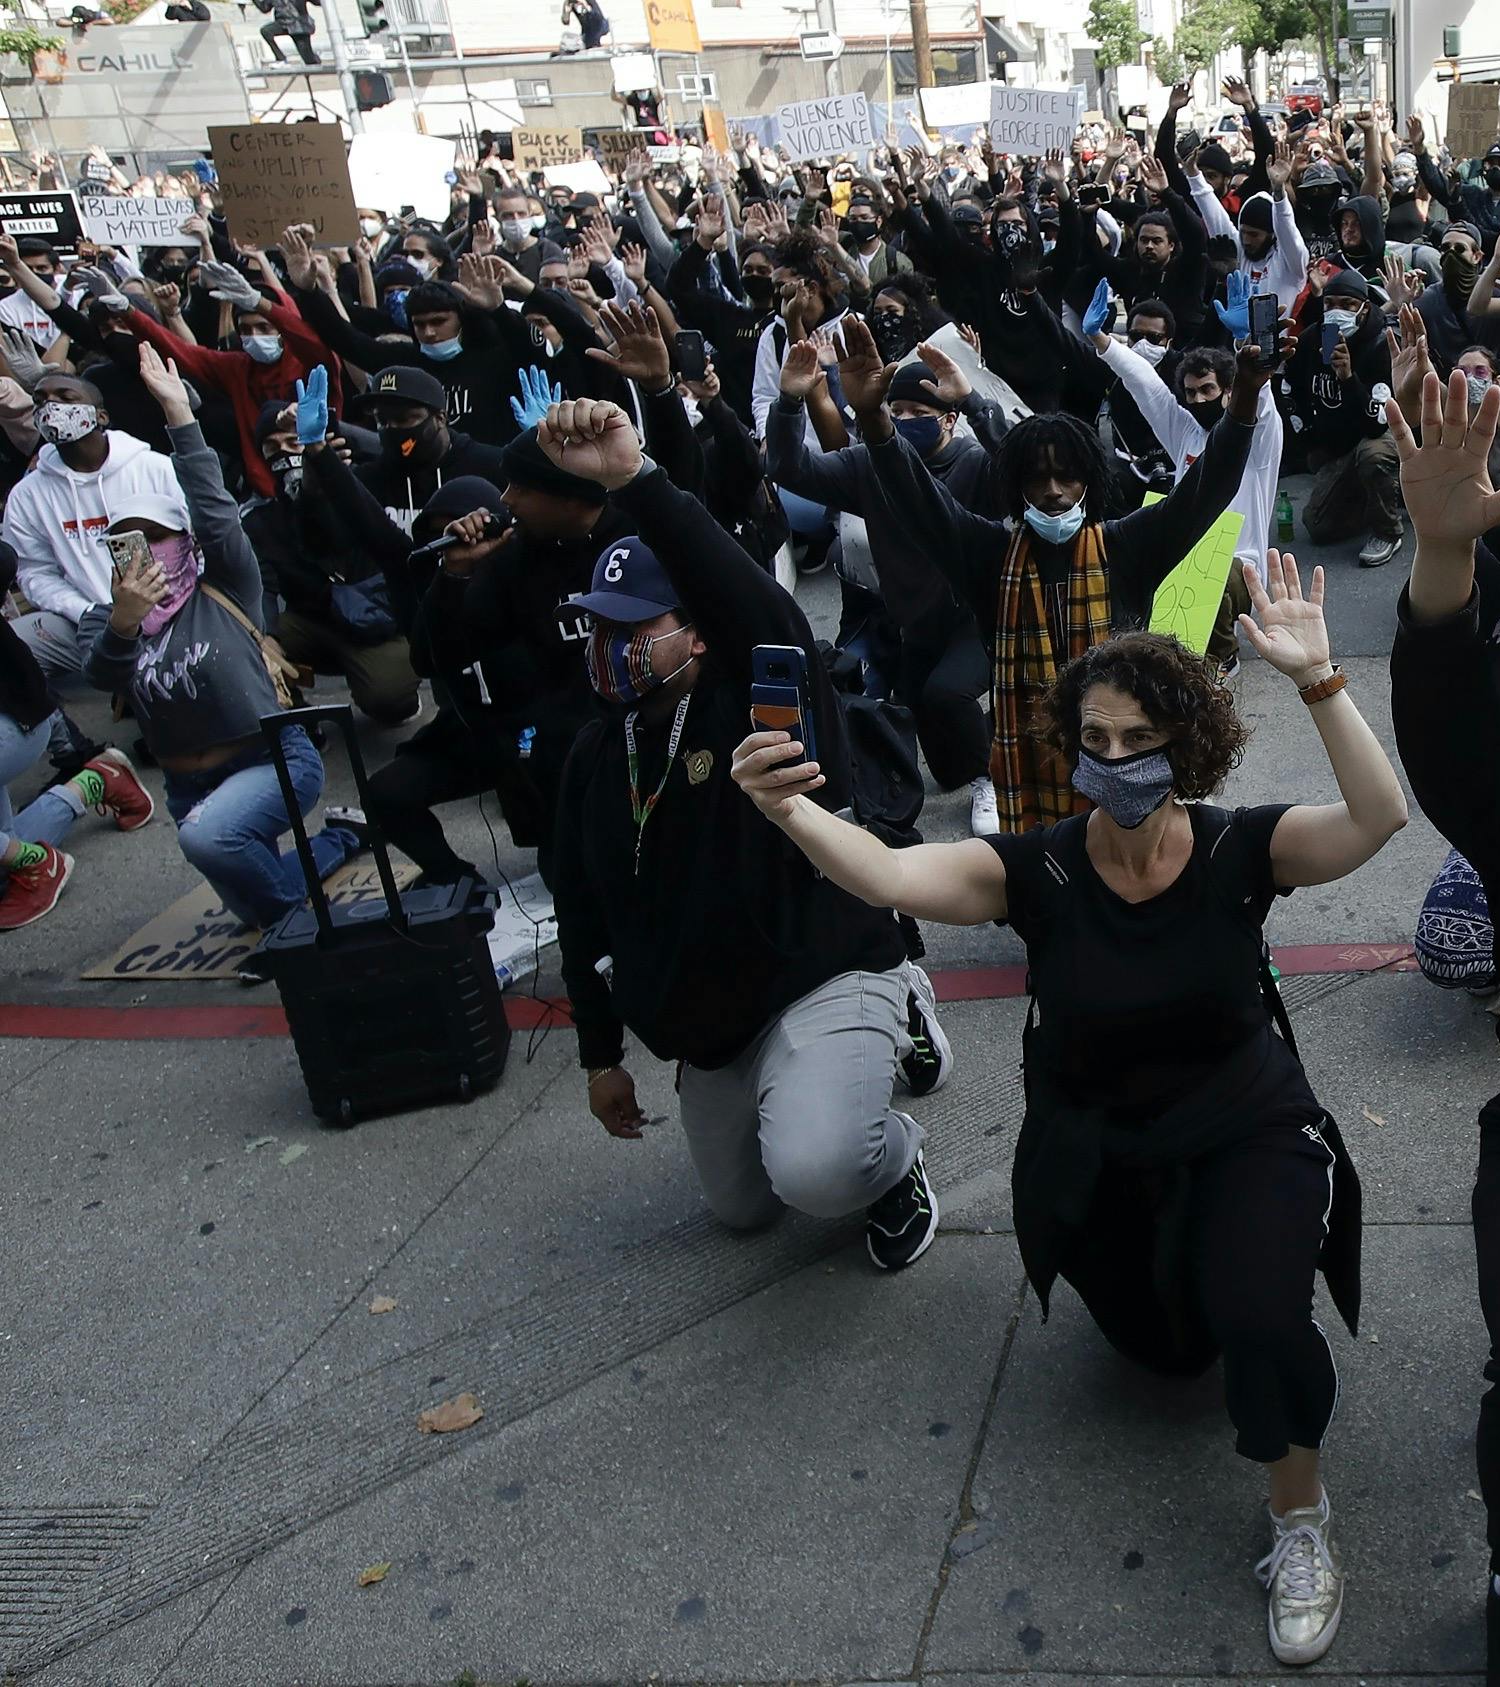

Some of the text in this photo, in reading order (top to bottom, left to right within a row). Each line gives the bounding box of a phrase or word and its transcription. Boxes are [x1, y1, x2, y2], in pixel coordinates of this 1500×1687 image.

[77, 51, 193, 73] CAHILL
[781, 96, 867, 129] SILENCE IS
[996, 90, 1076, 119] JUSTICE 4
[229, 132, 316, 153] CENTER
[518, 132, 569, 146] BLACK
[787, 120, 872, 155] VIOLENCE
[990, 119, 1041, 148] GEORGE
[253, 156, 324, 177] UPLIFT
[222, 182, 280, 200] BLACK
[0, 201, 64, 215] ACK LIVES
[89, 198, 195, 219] BLACK LIVES
[8, 221, 53, 232] MATTER
[106, 218, 178, 240] MATTER
[604, 547, 631, 583] E
